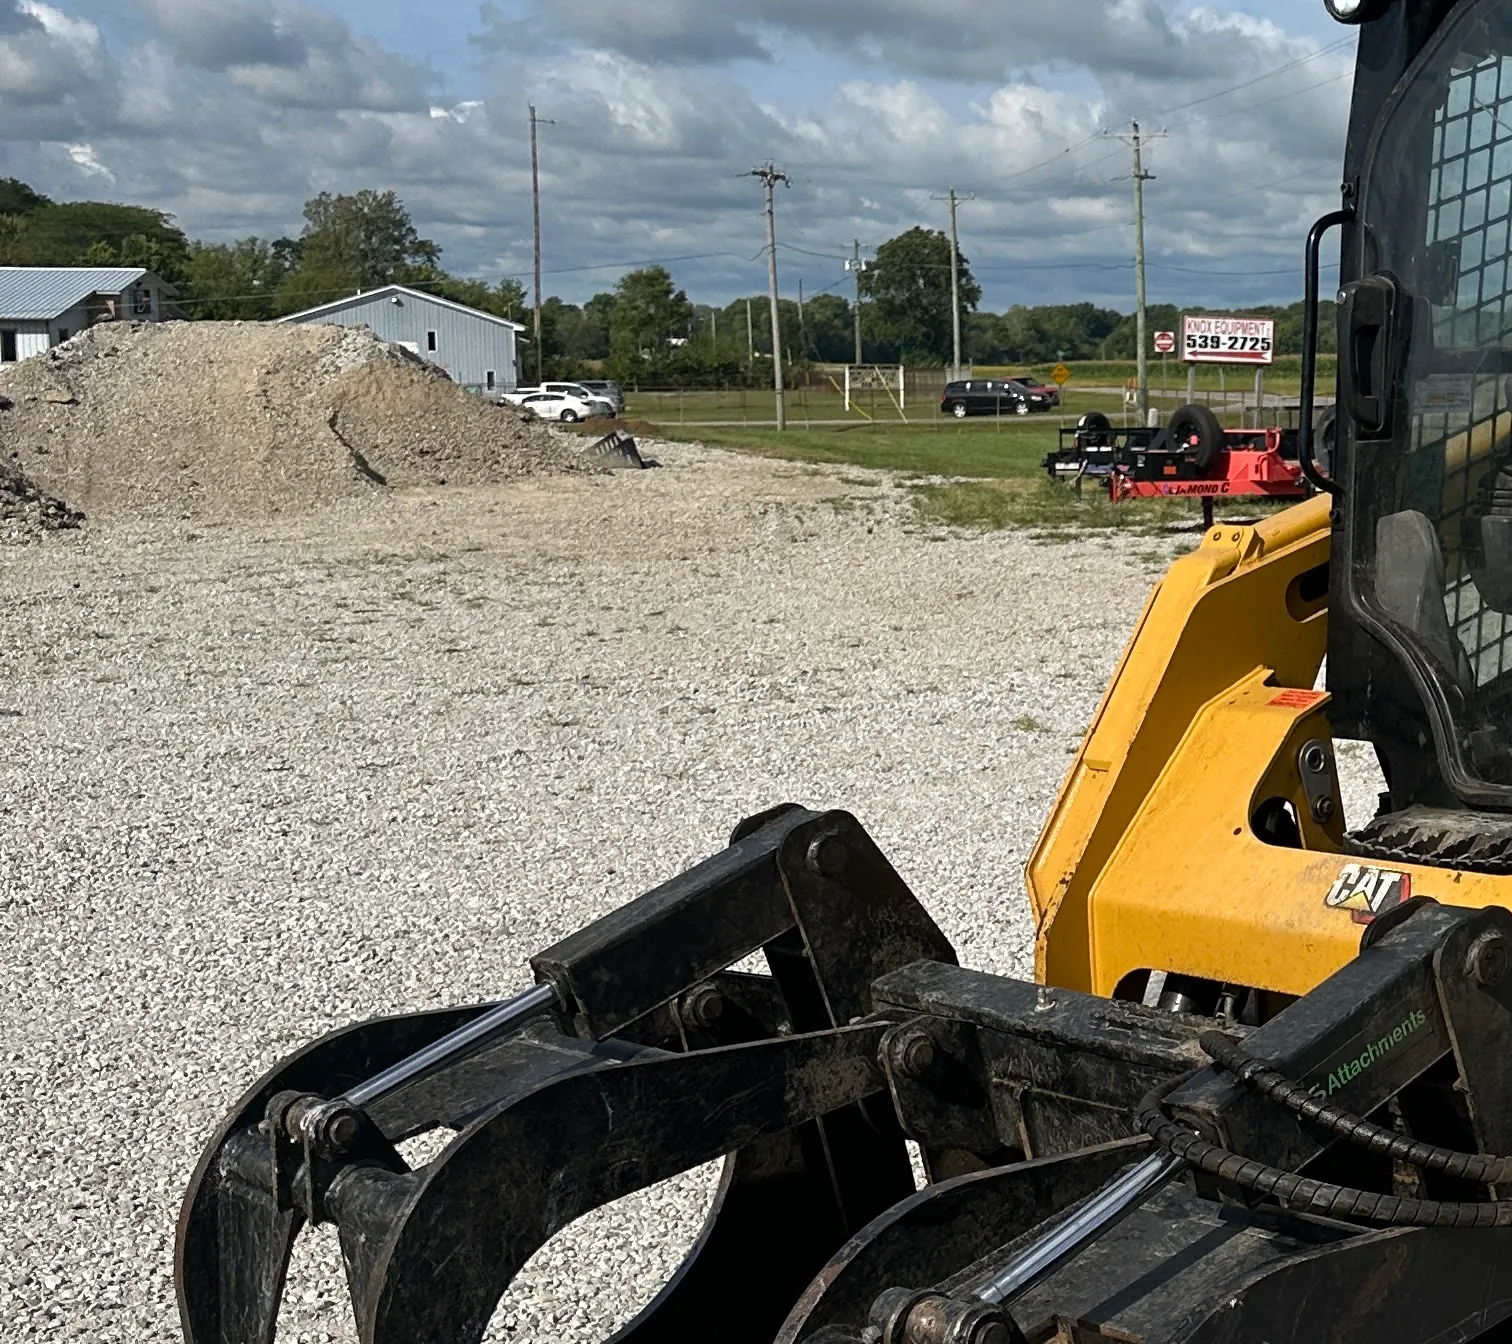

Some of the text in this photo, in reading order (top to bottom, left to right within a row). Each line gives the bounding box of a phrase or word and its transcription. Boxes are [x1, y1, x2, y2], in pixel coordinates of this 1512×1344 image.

[1186, 334, 1271, 351] 539-2725
[1187, 319, 1213, 334] KNOX
[1214, 320, 1266, 336] EQUIPMENT
[1326, 862, 1402, 913] CAT
[1327, 1008, 1426, 1096] Attachments
